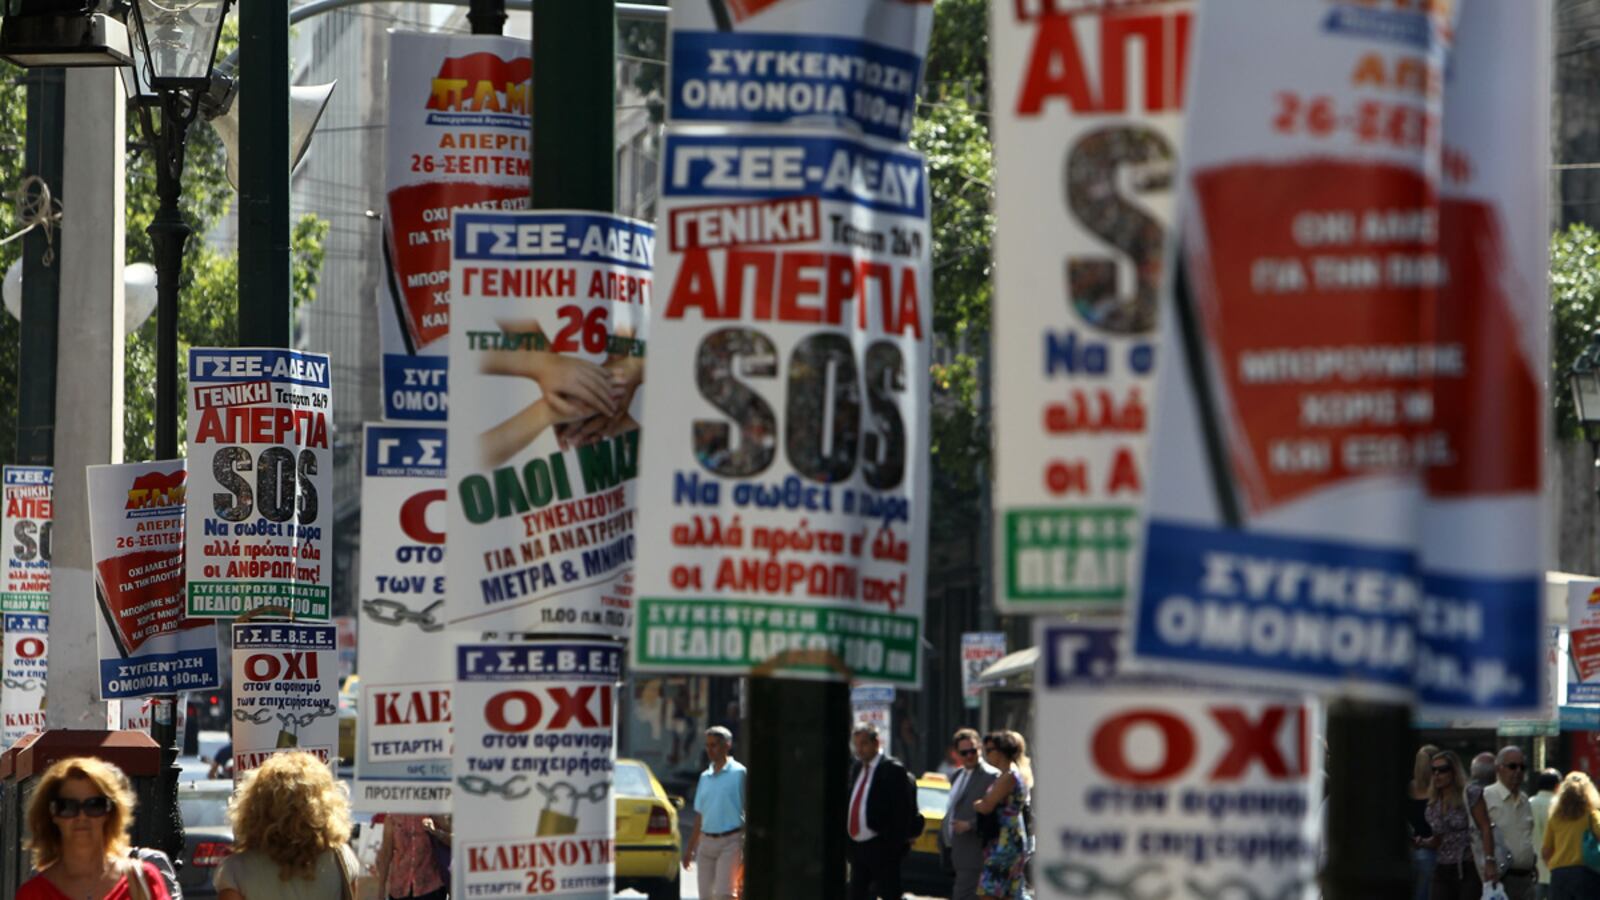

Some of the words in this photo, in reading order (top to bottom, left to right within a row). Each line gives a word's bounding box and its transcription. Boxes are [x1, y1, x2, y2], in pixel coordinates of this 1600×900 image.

[681, 79, 847, 113] ΟΜΟΝΟΙΑ
[439, 133, 530, 152] ΑΠΕΡΓΙ
[672, 146, 919, 209] ΓΣΕΕ-ΑΔΕΔΥ
[422, 207, 448, 222] ΟΧΙ
[676, 202, 814, 248] ΓΕΝΙΚΗ
[408, 231, 428, 246] ΓΙΑ
[465, 222, 655, 266] ΓΣΕΕ-ΑΔΕΔΥ
[407, 270, 450, 288] ΜΠΟΡ
[463, 267, 576, 298] ΓΕΝΙΚΗ
[1252, 257, 1305, 293] ΓΙΑ
[422, 312, 448, 328] ΚΑΙ
[550, 304, 608, 354] 26
[1045, 329, 1108, 377] Να
[196, 355, 326, 383] ΓΣΕΕ-ΑΔΕΔΥ
[404, 368, 446, 386] ΣΥΓ
[198, 382, 268, 408] ΓΕΝΙΚΗ
[692, 326, 906, 490] SOS
[1043, 386, 1147, 434] αλλά
[1044, 457, 1089, 497] οι
[1107, 446, 1142, 497] Α
[212, 446, 318, 524] SOS
[458, 450, 572, 525] ΟΛΟΙ
[674, 470, 719, 505] Να
[204, 519, 228, 536] Να
[672, 515, 743, 548] αλλά
[752, 517, 844, 556] πρώτα
[204, 540, 240, 557] αλλά
[244, 540, 289, 560] πρώτα
[484, 546, 517, 573] ΓΙΑ
[520, 538, 544, 563] ΝΑ
[128, 566, 144, 577] ΟΧΙ
[204, 565, 220, 578] οι
[480, 560, 557, 605] ΜΕΤΡΑ
[560, 558, 579, 584] &
[670, 564, 703, 590] οι
[119, 581, 134, 592] ΓΙΑ
[193, 584, 278, 594] ΣΥΓΚΕΝΤΡΩΣΗ
[376, 576, 425, 594] των
[193, 595, 241, 611] ΠΕΔΙΟ
[646, 625, 743, 659] ΠΕΔΙΟ
[1155, 595, 1415, 670] ΟΜΟΝΟΙΑ
[244, 651, 319, 682] ΟΧΙ
[108, 676, 168, 692] ΟΜΟΝΟΙΑ
[243, 681, 270, 692] στον
[237, 696, 256, 706] των
[374, 690, 452, 726] ΚΛΕ
[484, 685, 612, 733] ΟΧΙ
[371, 739, 443, 756] ΤΕΤΑΡΤΗ
[482, 734, 529, 748] στον
[407, 765, 426, 776] ως
[468, 757, 506, 771] των
[1085, 787, 1168, 815] στον
[1061, 828, 1127, 854] των
[467, 881, 522, 896] ΤΕΤΑΡΤΗ
[525, 871, 555, 894] 26
